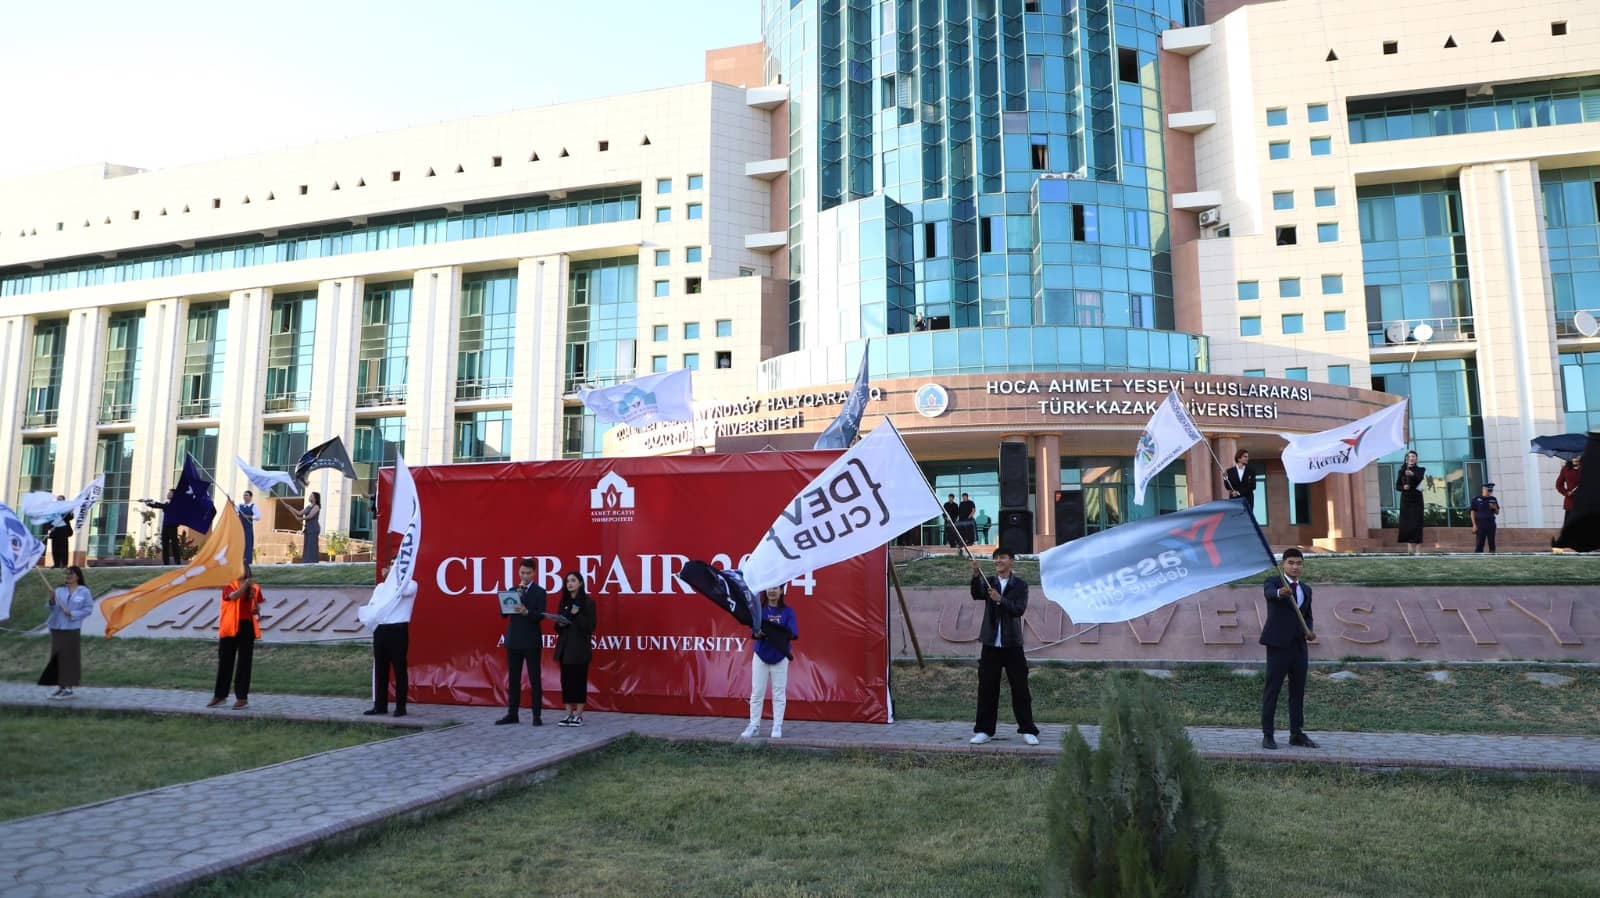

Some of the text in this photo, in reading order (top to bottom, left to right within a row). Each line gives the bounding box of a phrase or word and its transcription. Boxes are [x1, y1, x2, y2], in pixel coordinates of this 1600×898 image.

[764, 387, 882, 411] HALYQARAQ
[986, 380, 1040, 395] HOCA
[1048, 379, 1113, 394] AHMET
[1194, 382, 1312, 401] ULUSLARARASI
[1037, 397, 1278, 419] TÜRK-KAZAK NİVERSİTESİ
[636, 634, 748, 652] UNIVERSITY
